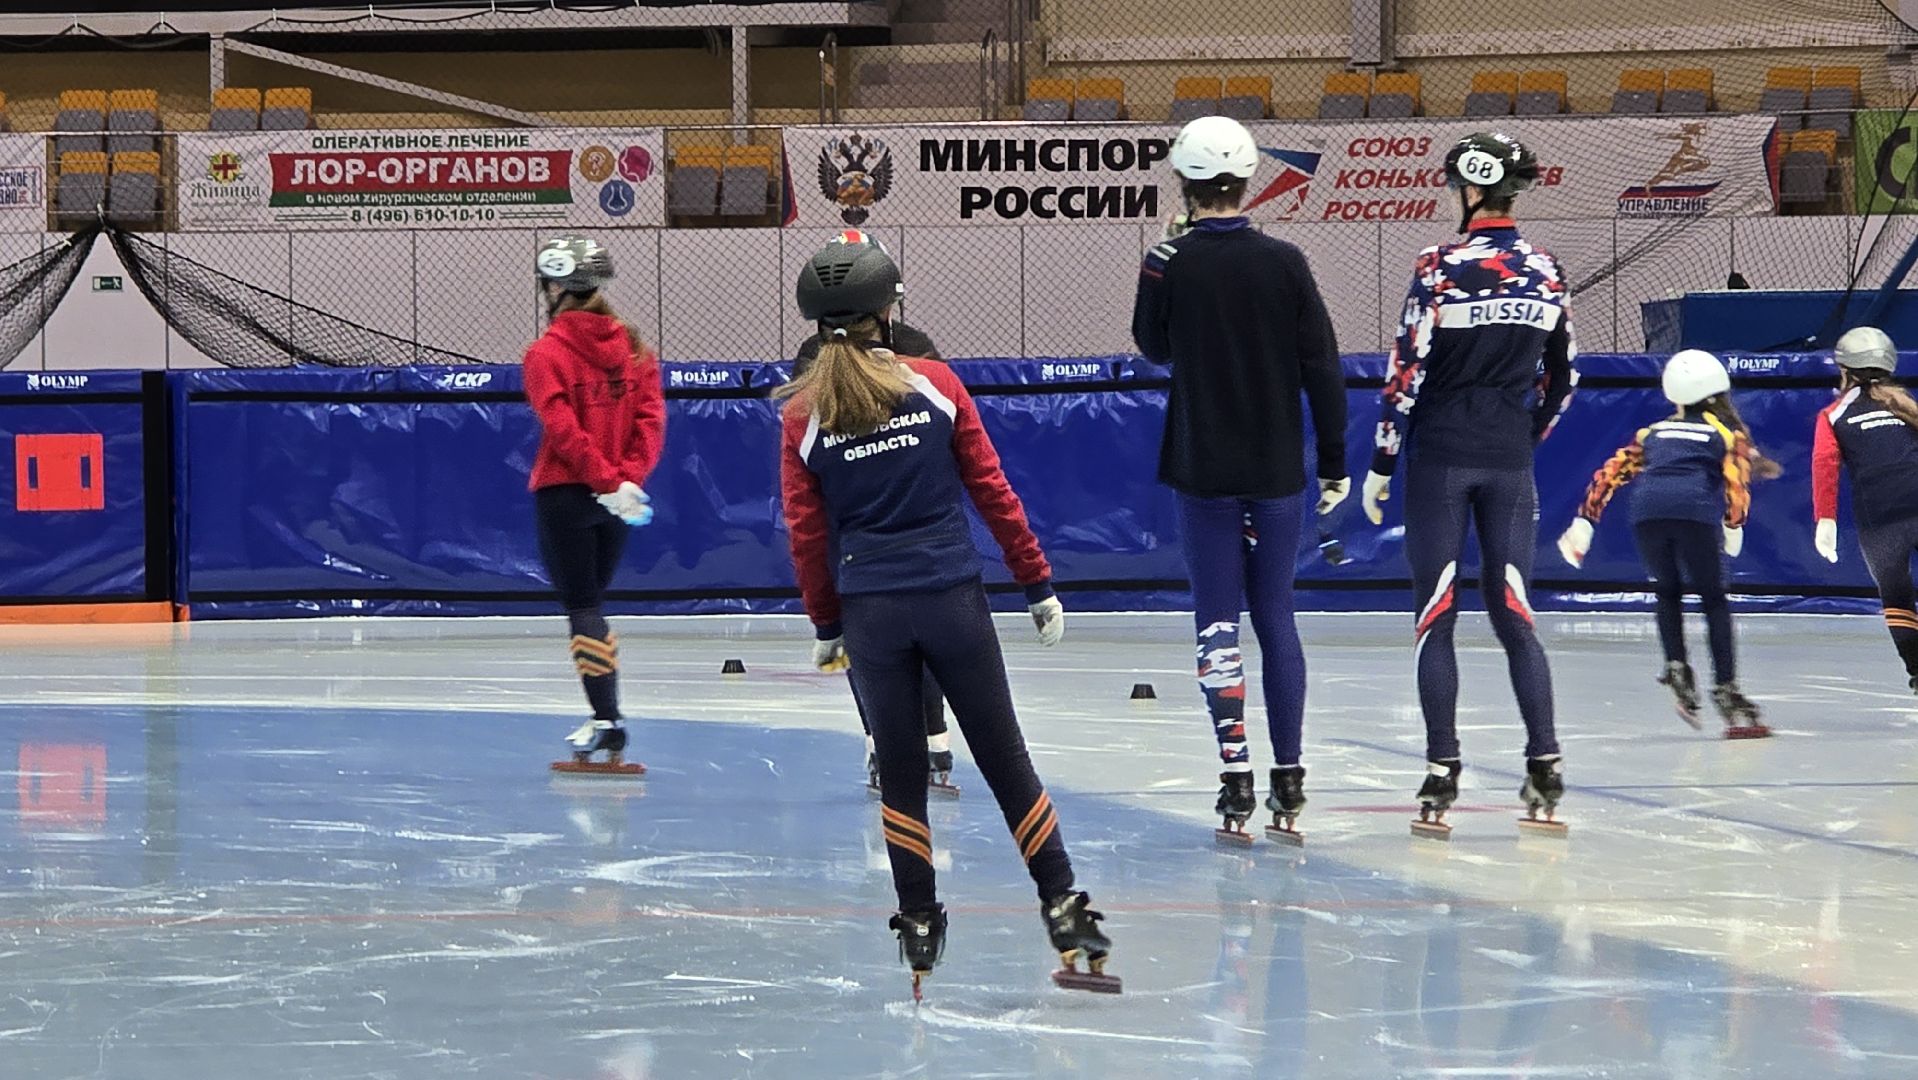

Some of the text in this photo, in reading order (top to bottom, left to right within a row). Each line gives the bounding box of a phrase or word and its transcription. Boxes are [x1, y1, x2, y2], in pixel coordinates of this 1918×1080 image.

[312, 134, 530, 150] ОПЕРАТИВНОЕ ЛЕЧЕНИЕ
[1348, 137, 1432, 157] СОЮЗ
[919, 138, 1177, 172] МИНСПОР
[291, 155, 551, 185] ЛОР-ОРГАНОВ
[1466, 156, 1493, 179] 68
[318, 193, 360, 204] новом
[363, 191, 463, 206] хирургическом
[466, 190, 537, 204] отделении
[960, 184, 1158, 219] РОССИИ
[351, 208, 495, 225] 8 (496) 610-10-10
[1321, 199, 1438, 220] РОССИИ
[1469, 302, 1545, 324] RUSSIA
[1055, 363, 1100, 376] OLYMP
[1740, 358, 1780, 369] OLYMP
[41, 375, 88, 387] OLYMP
[684, 370, 729, 382] OLYMP
[843, 433, 920, 461] ОБЛАСТЬ
